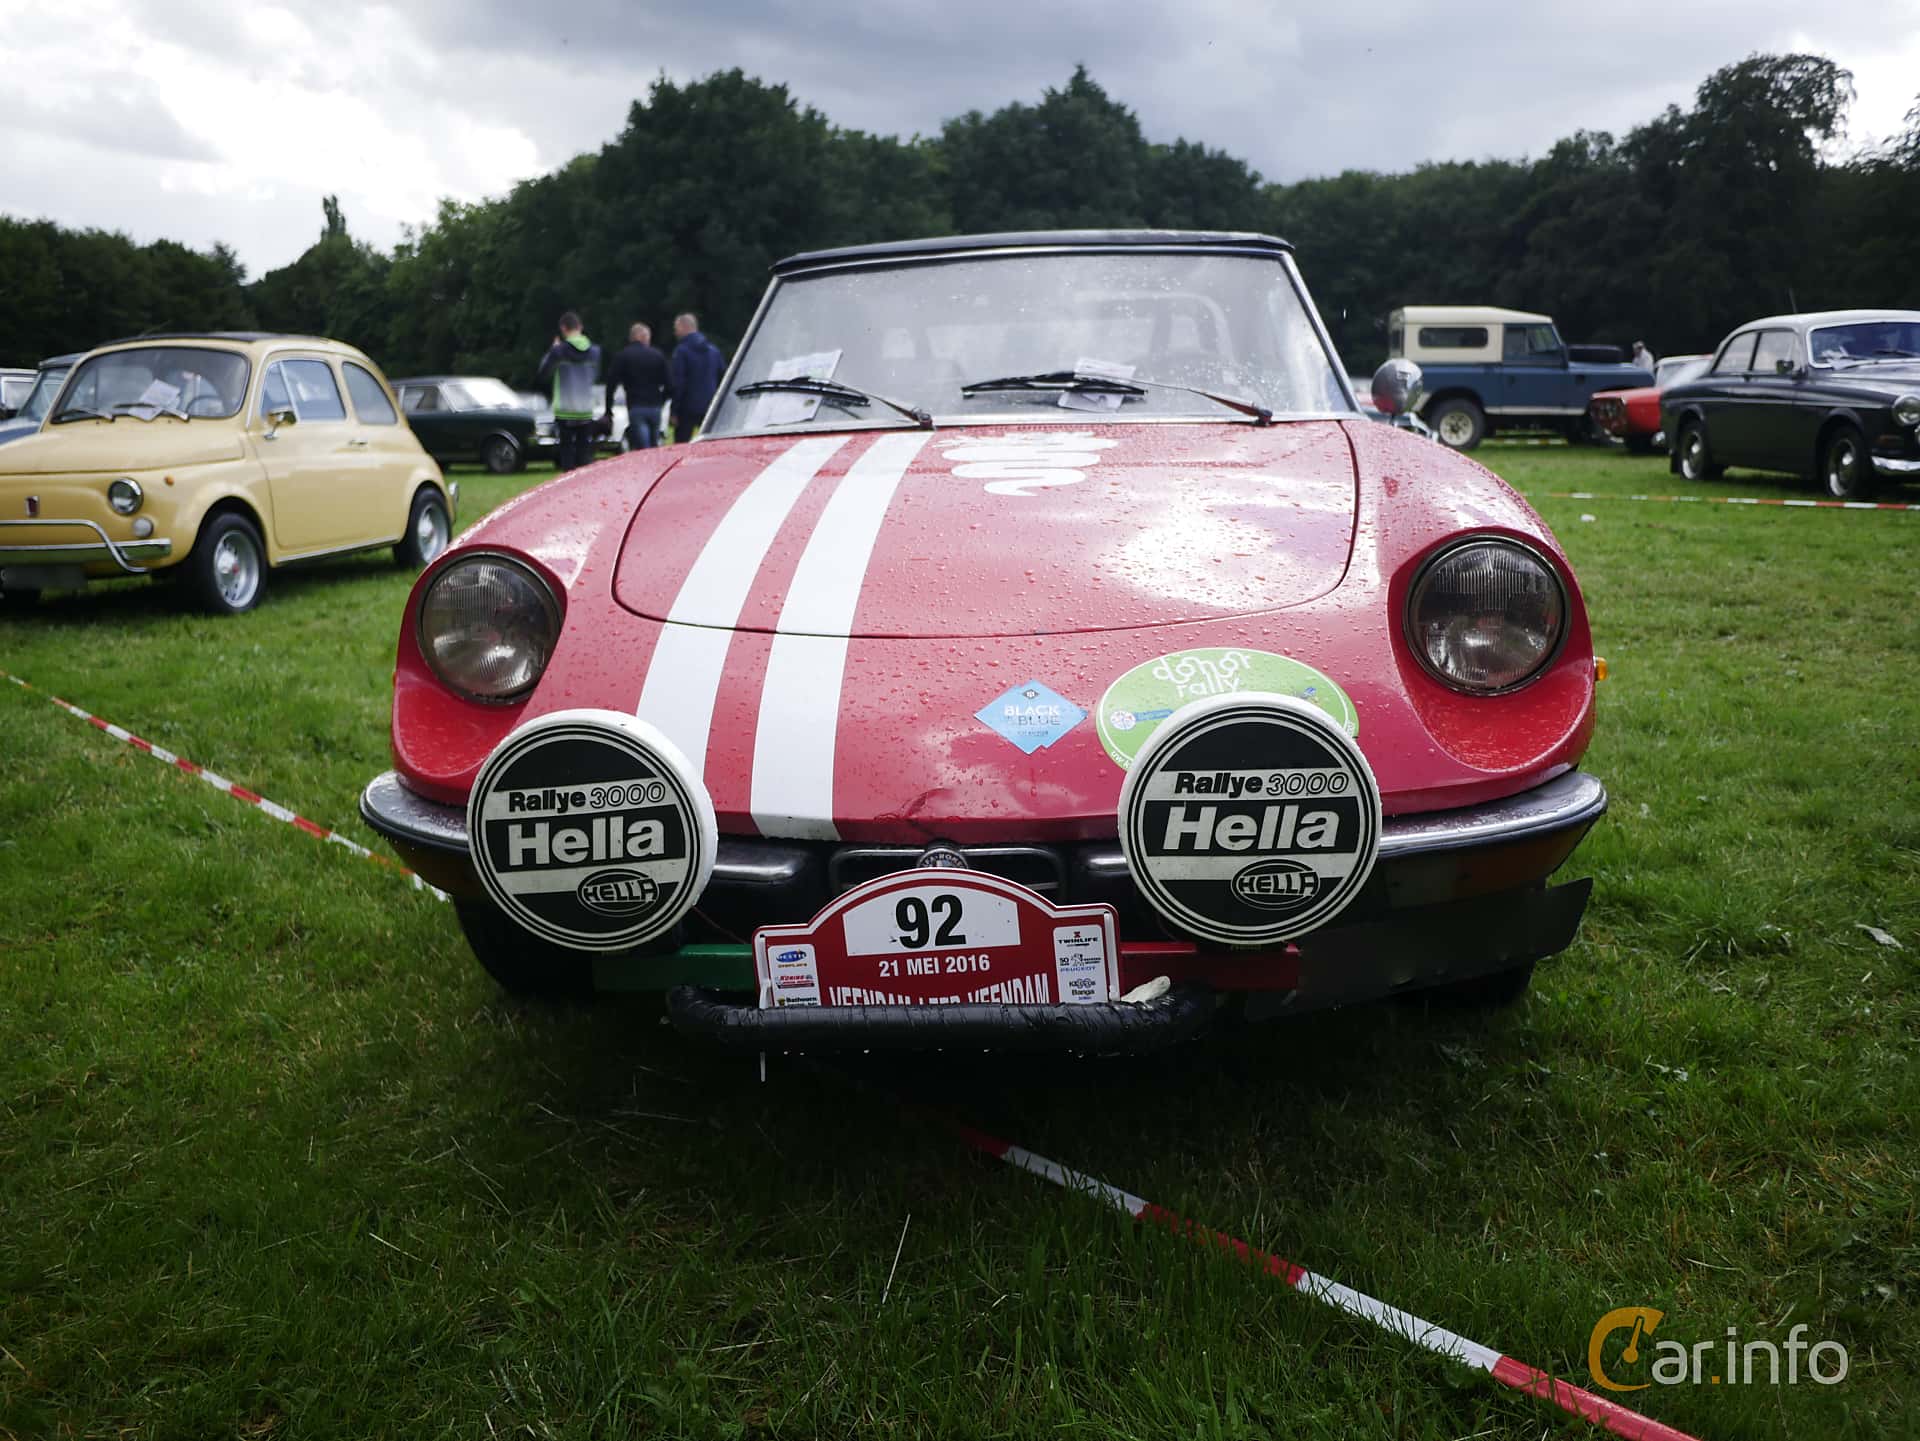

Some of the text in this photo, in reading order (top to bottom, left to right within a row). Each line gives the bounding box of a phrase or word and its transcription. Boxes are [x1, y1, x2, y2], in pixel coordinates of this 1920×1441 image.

[1004, 704, 1061, 716] BLACK
[1018, 715, 1061, 726] BLUE
[509, 782, 666, 814] Rallye 3000
[1174, 772, 1349, 798] Rallye 3000
[1162, 804, 1340, 851] Hella
[508, 815, 665, 867] Hella
[583, 877, 658, 903] HELLA
[1238, 871, 1319, 898] HELLA
[895, 895, 967, 949] 92
[878, 954, 990, 977] 21 MEI 2016
